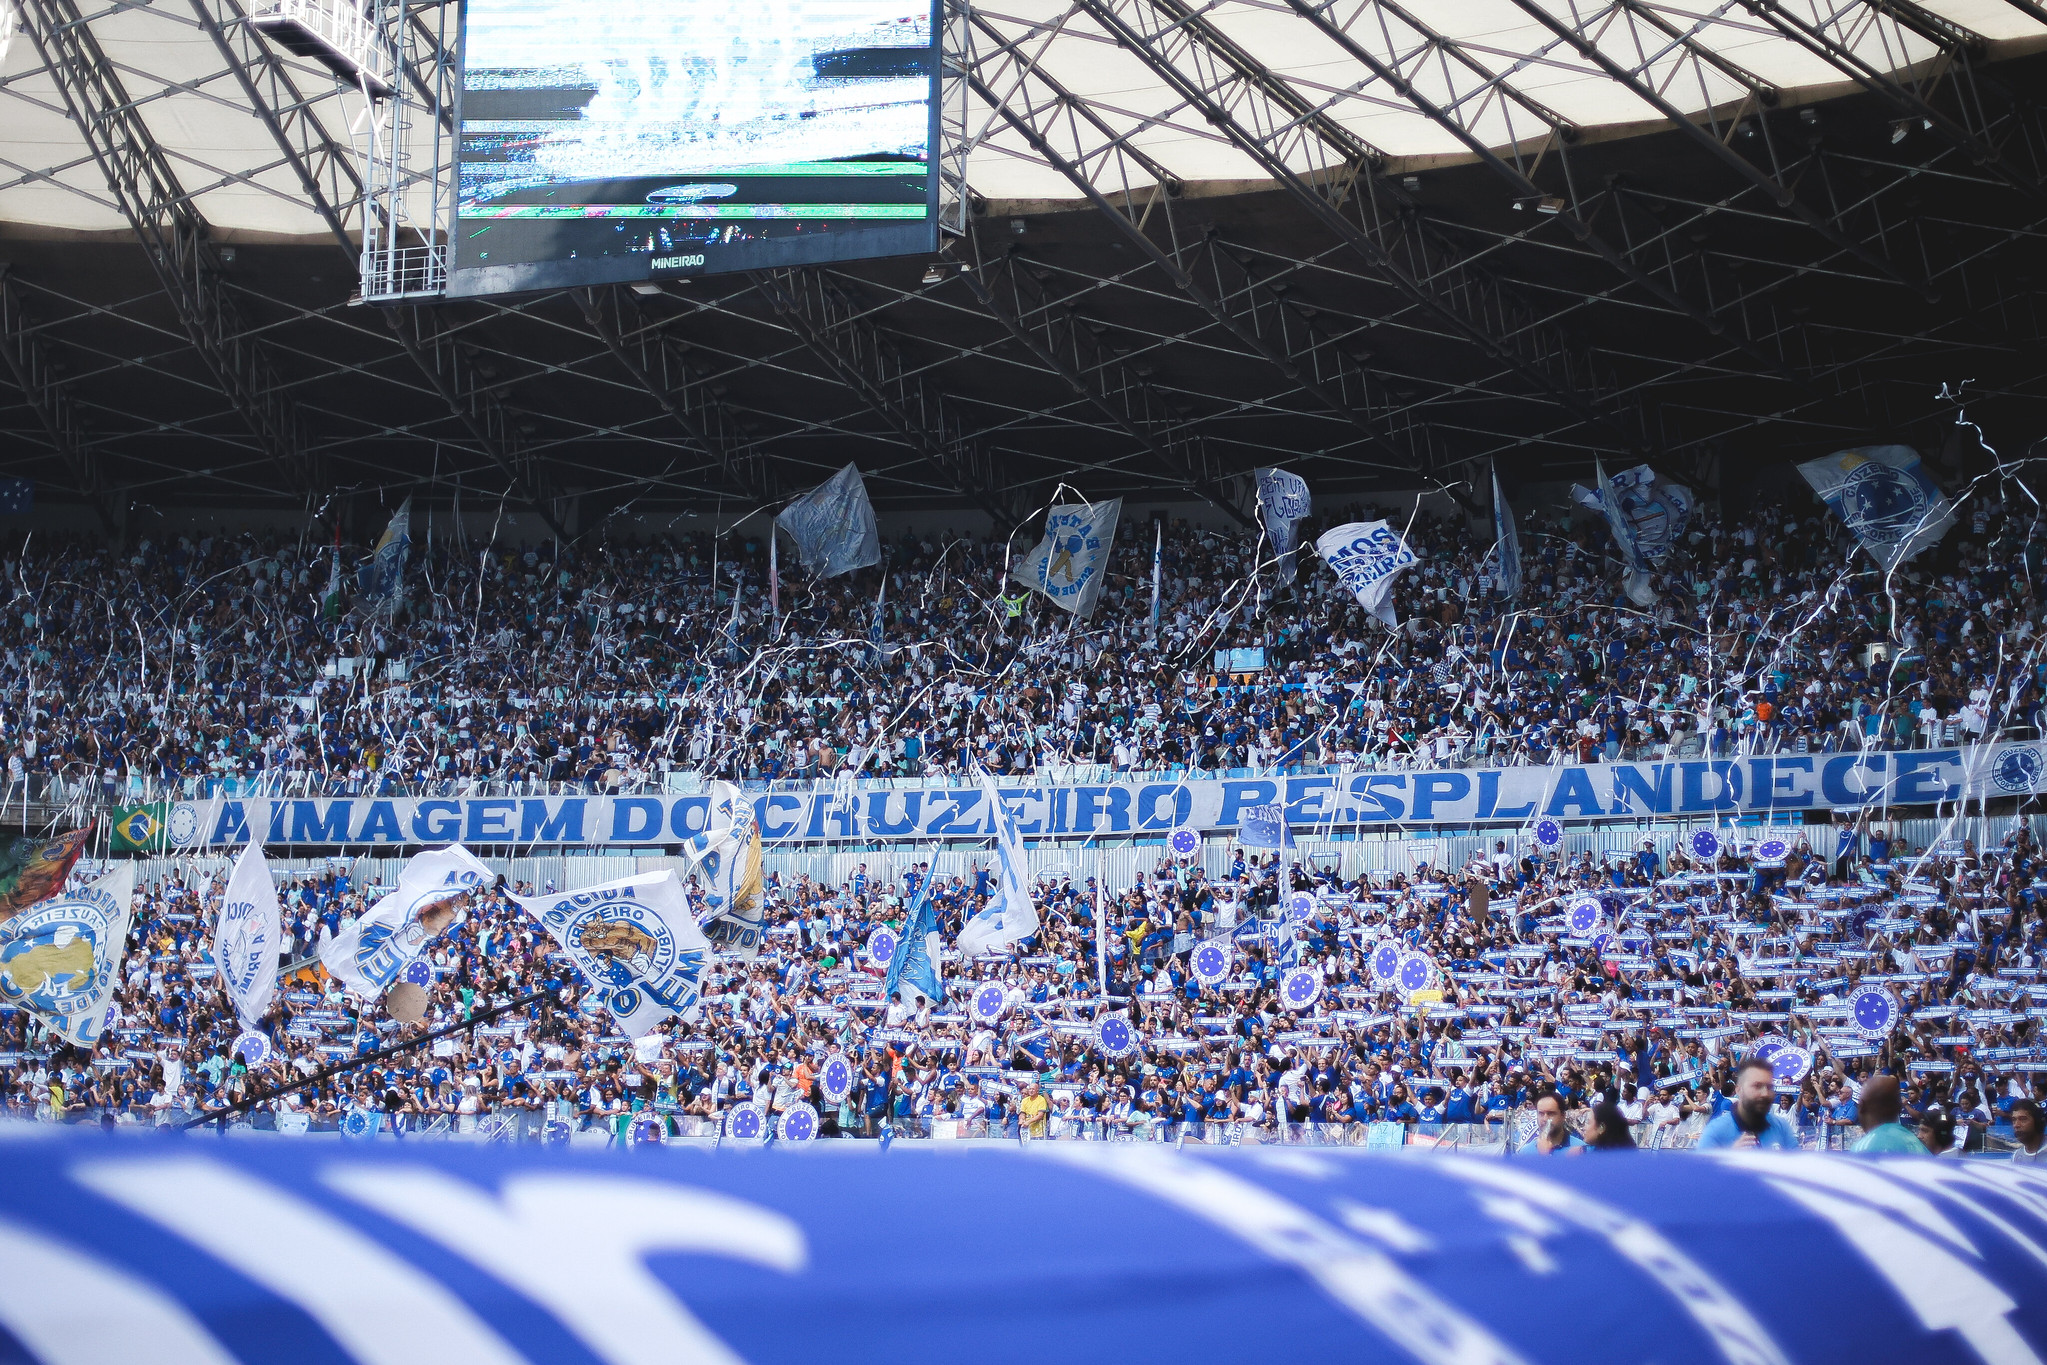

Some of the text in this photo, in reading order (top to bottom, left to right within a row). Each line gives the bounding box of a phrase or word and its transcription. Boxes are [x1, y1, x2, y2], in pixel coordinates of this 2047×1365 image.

[210, 801, 252, 843] A
[267, 798, 588, 843] IMAGEM
[609, 797, 712, 841] DO
[754, 784, 1193, 838] CRUZEIRO
[1214, 749, 1962, 826] RESPLANDECE
[542, 886, 636, 932] TORCIDA
[655, 926, 671, 973] LUBE
[1848, 987, 1885, 1011] CRUZEIRO
[1887, 997, 1897, 1027] CLUBE
[1102, 1012, 1134, 1036] CRUZEIRO
[1850, 1017, 1886, 1037] ESPORTE
[627, 1113, 655, 1140] CRUEIRO
[727, 1103, 750, 1135] CRUZEIRO
[787, 1104, 816, 1122] CRUZEIRO
[1521, 1119, 1537, 1142] CRUZ
